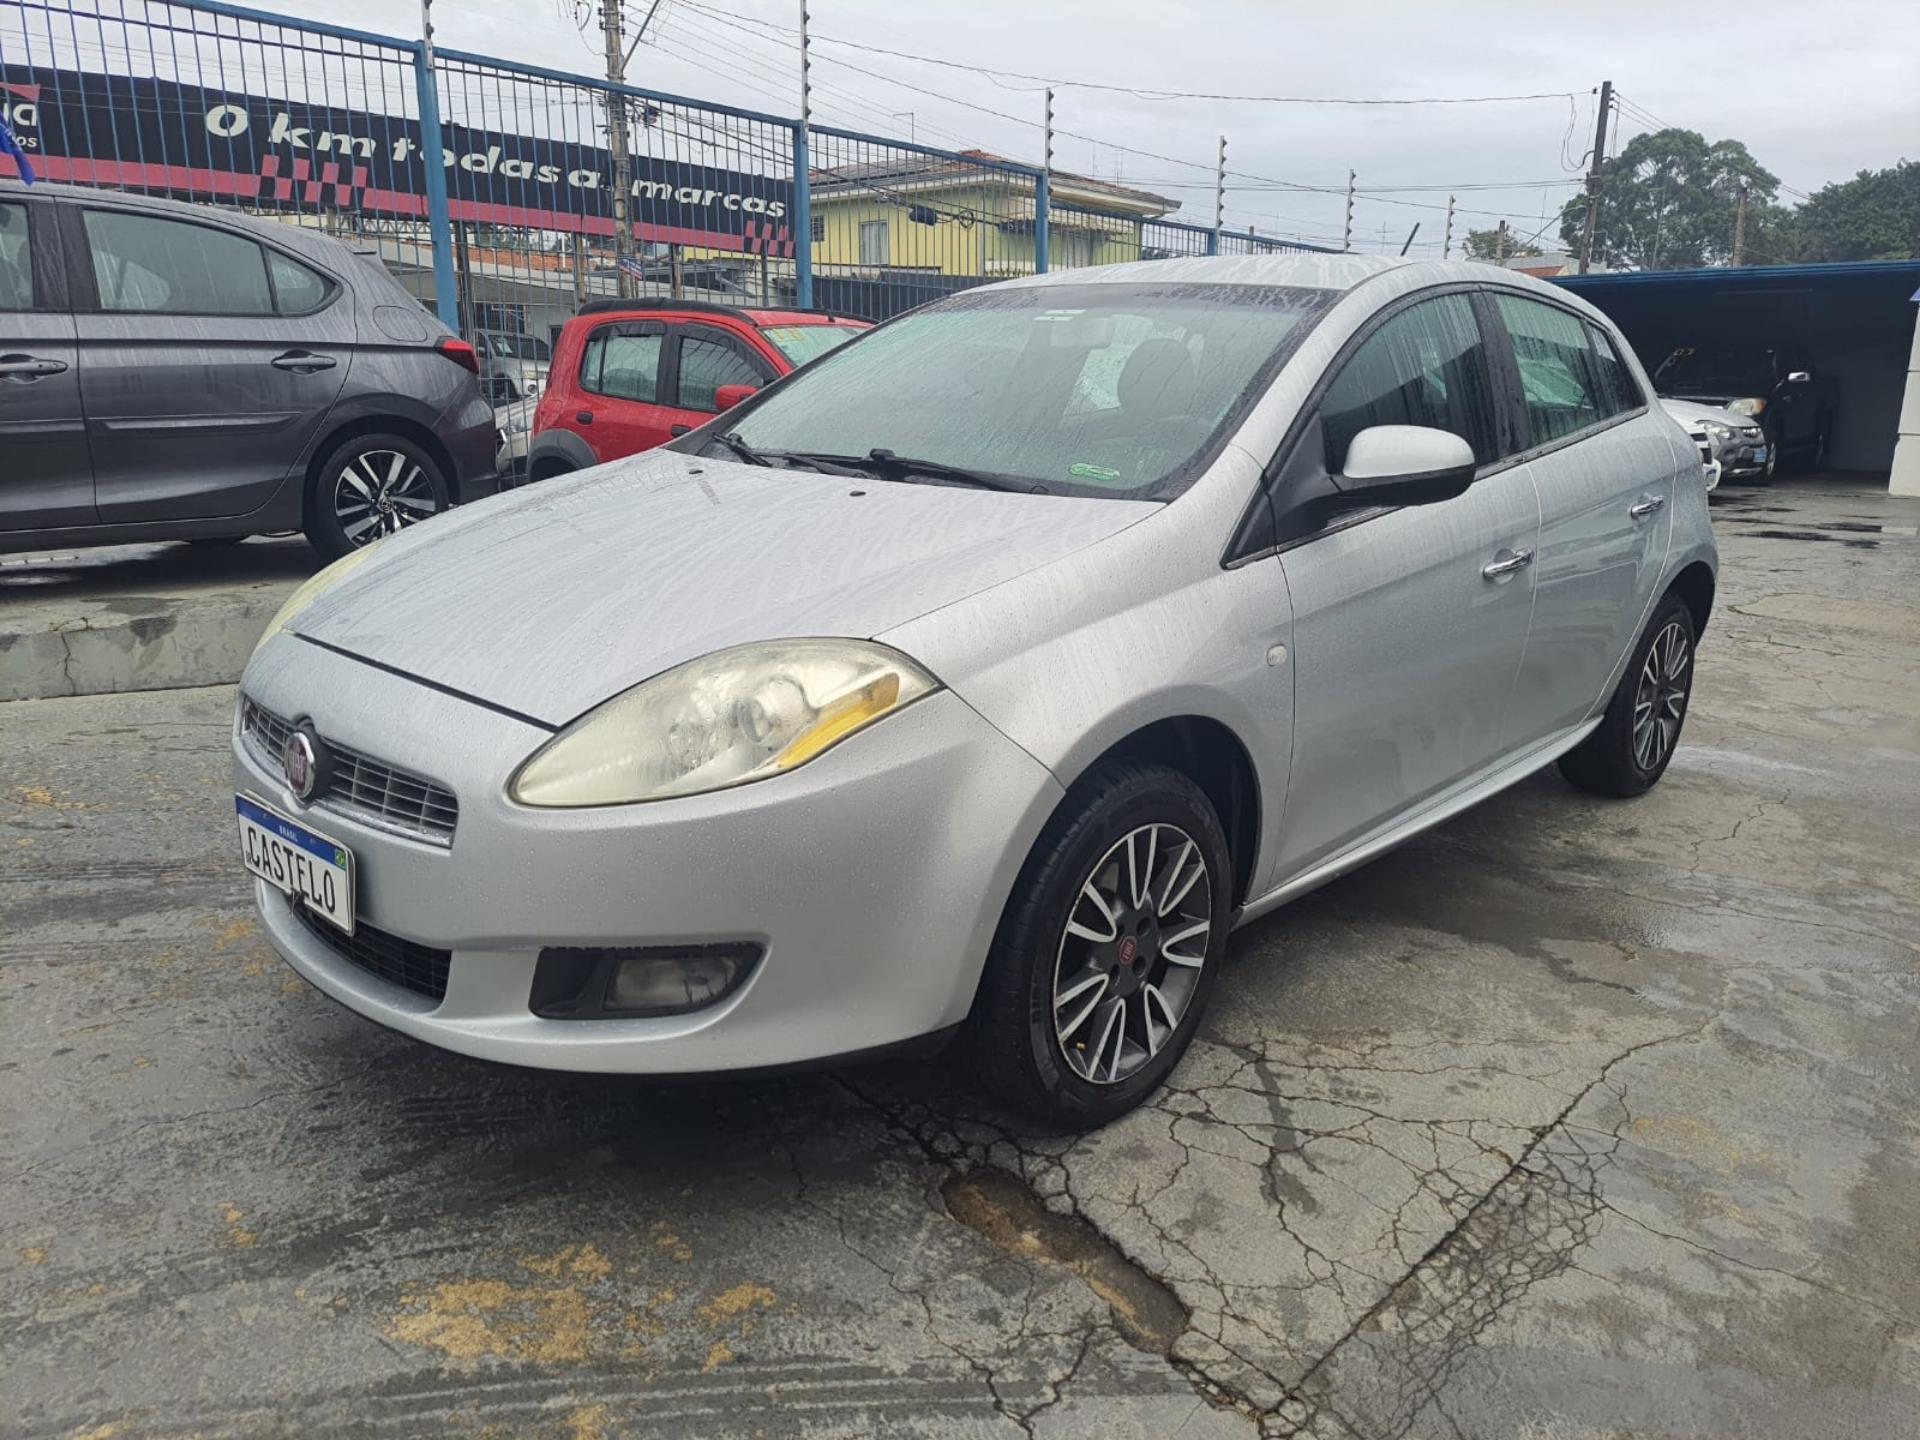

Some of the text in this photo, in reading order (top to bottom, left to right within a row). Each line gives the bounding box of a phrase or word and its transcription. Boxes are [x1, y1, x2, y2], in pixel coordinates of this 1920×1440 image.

[268, 112, 376, 158] km
[568, 169, 614, 192] a
[631, 179, 787, 218] marcas
[247, 826, 336, 914] CASTELO
